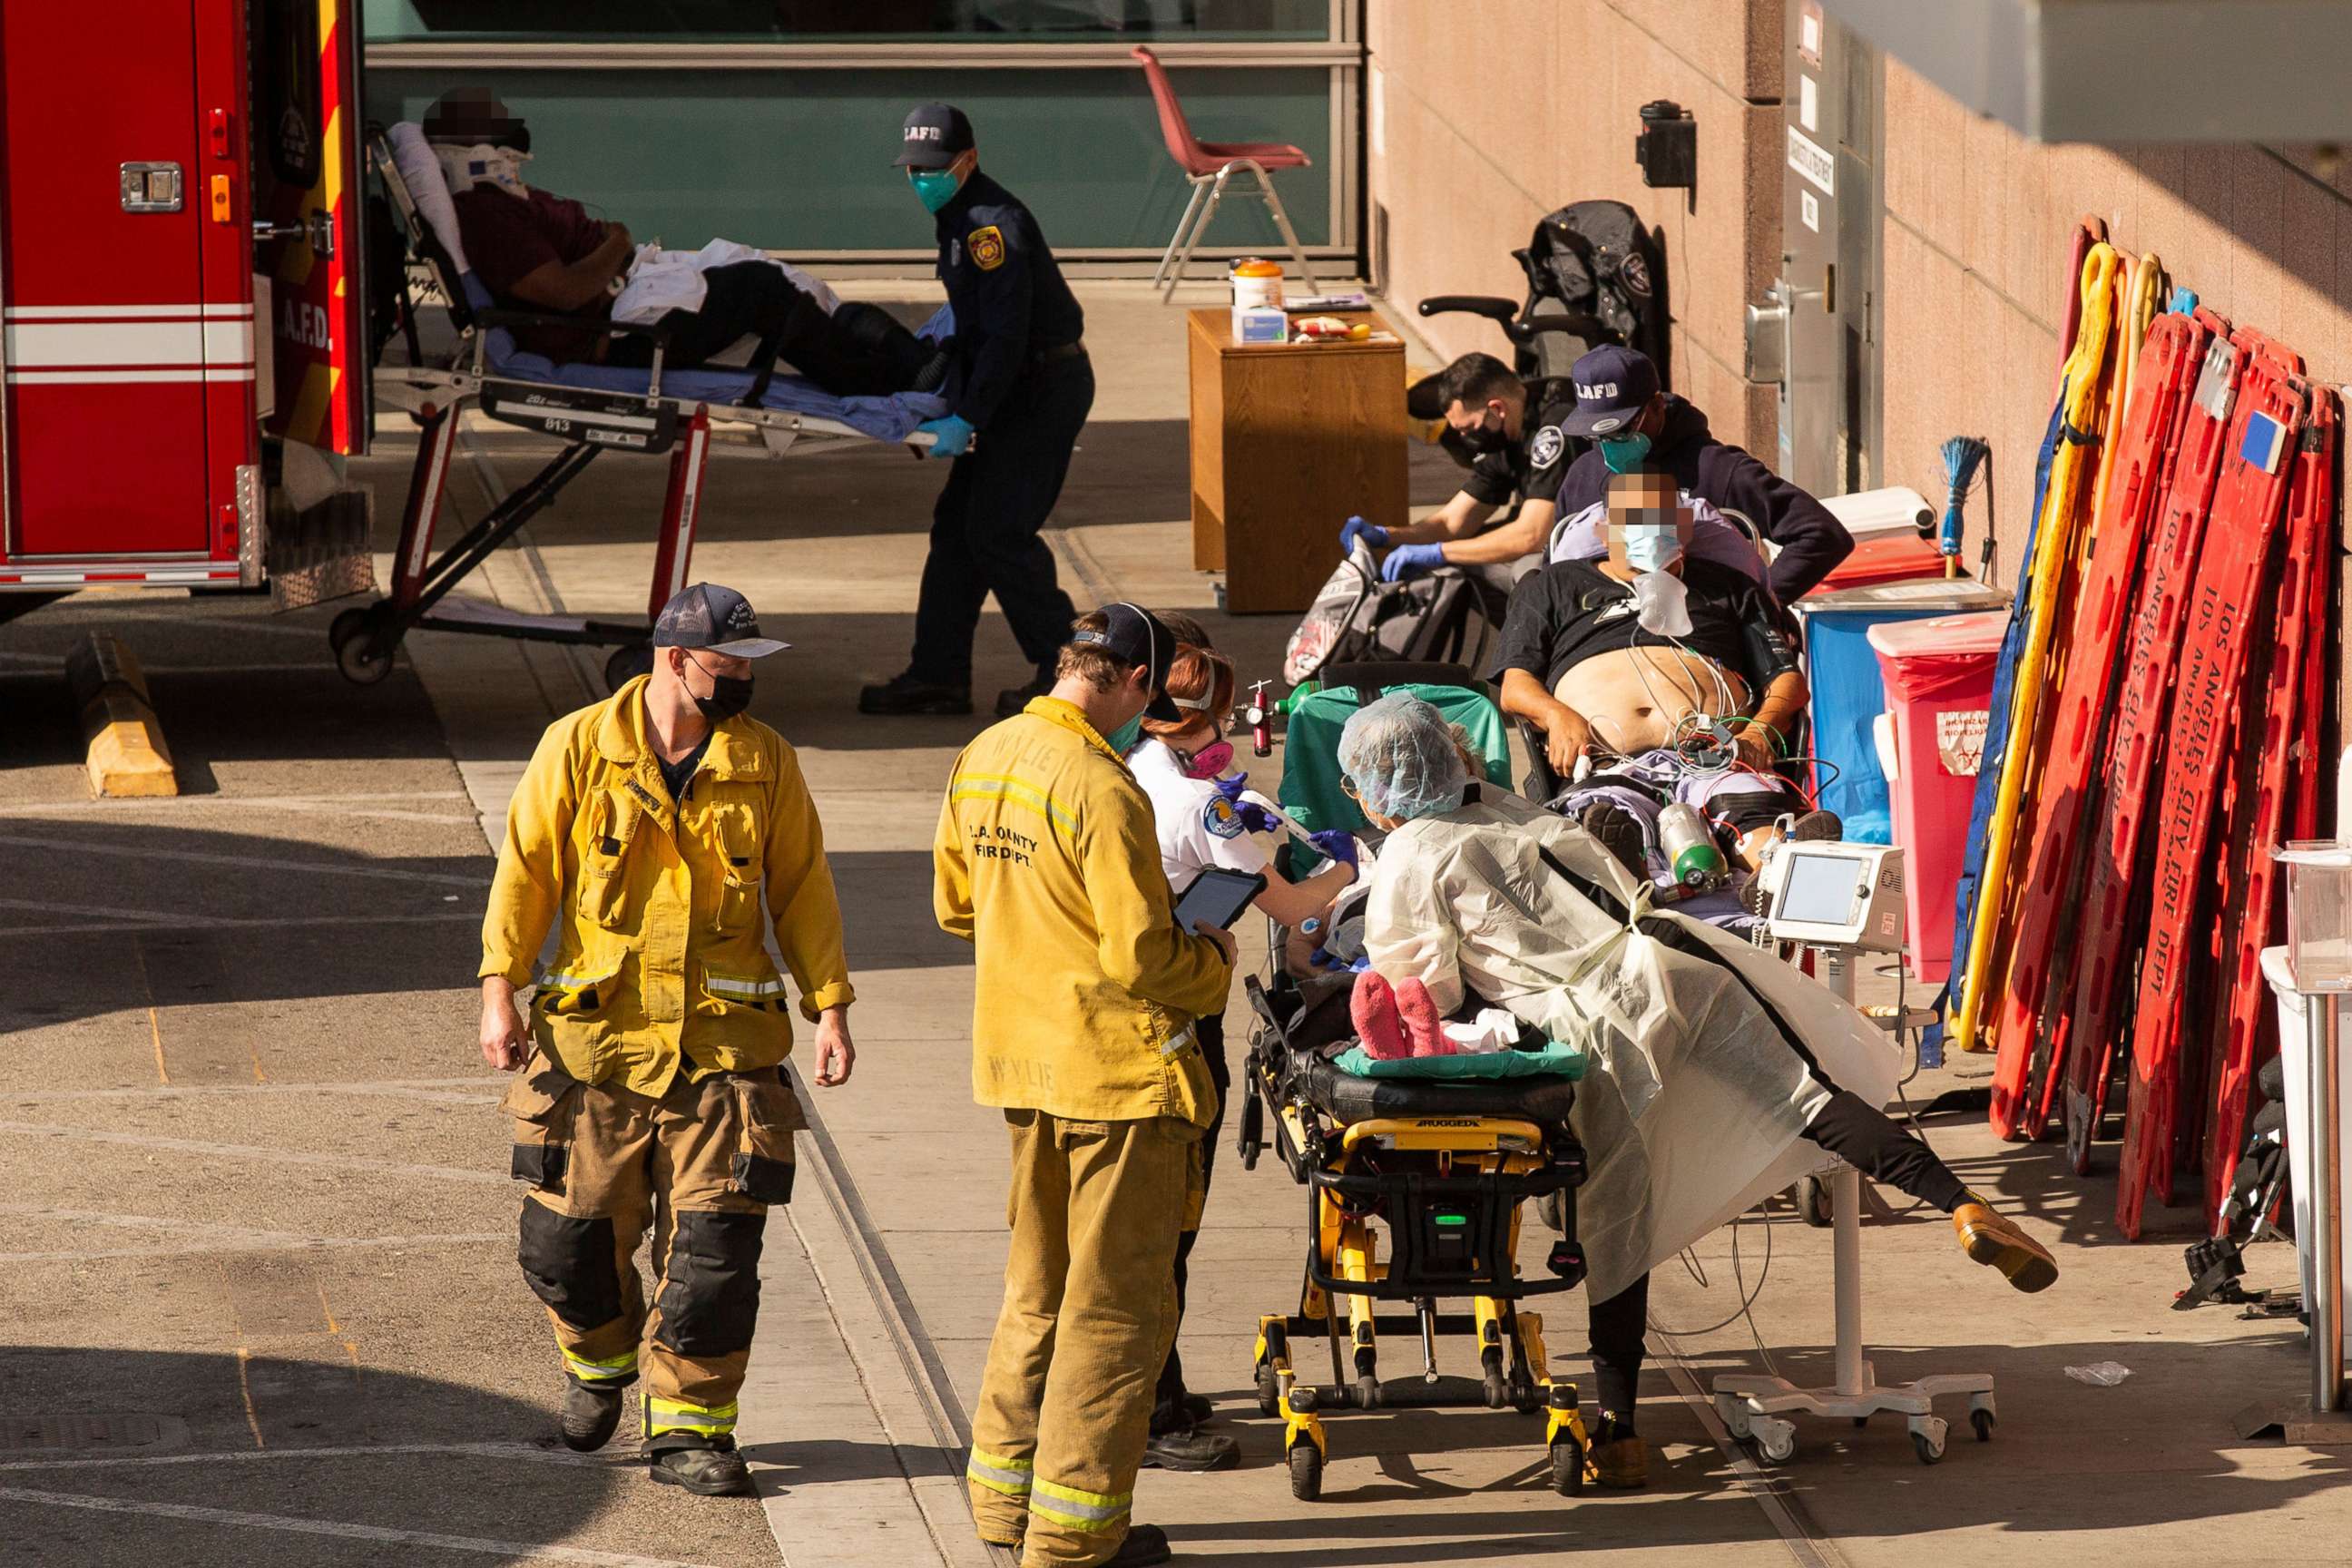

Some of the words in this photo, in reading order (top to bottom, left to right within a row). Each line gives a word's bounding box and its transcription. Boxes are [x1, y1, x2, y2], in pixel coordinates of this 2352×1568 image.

[904, 126, 941, 142] LAFD
[1575, 382, 1619, 399] LAFD
[545, 417, 571, 432] 813
[2164, 509, 2180, 554] LOS
[2216, 602, 2237, 651] LOS
[2123, 691, 2141, 750] CITY
[2189, 661, 2221, 779] ANGELES
[2175, 789, 2196, 852] CITY
[2163, 860, 2183, 919] FIRE
[2151, 928, 2171, 997] DEPT
[987, 1055, 1054, 1092] WYLIE
